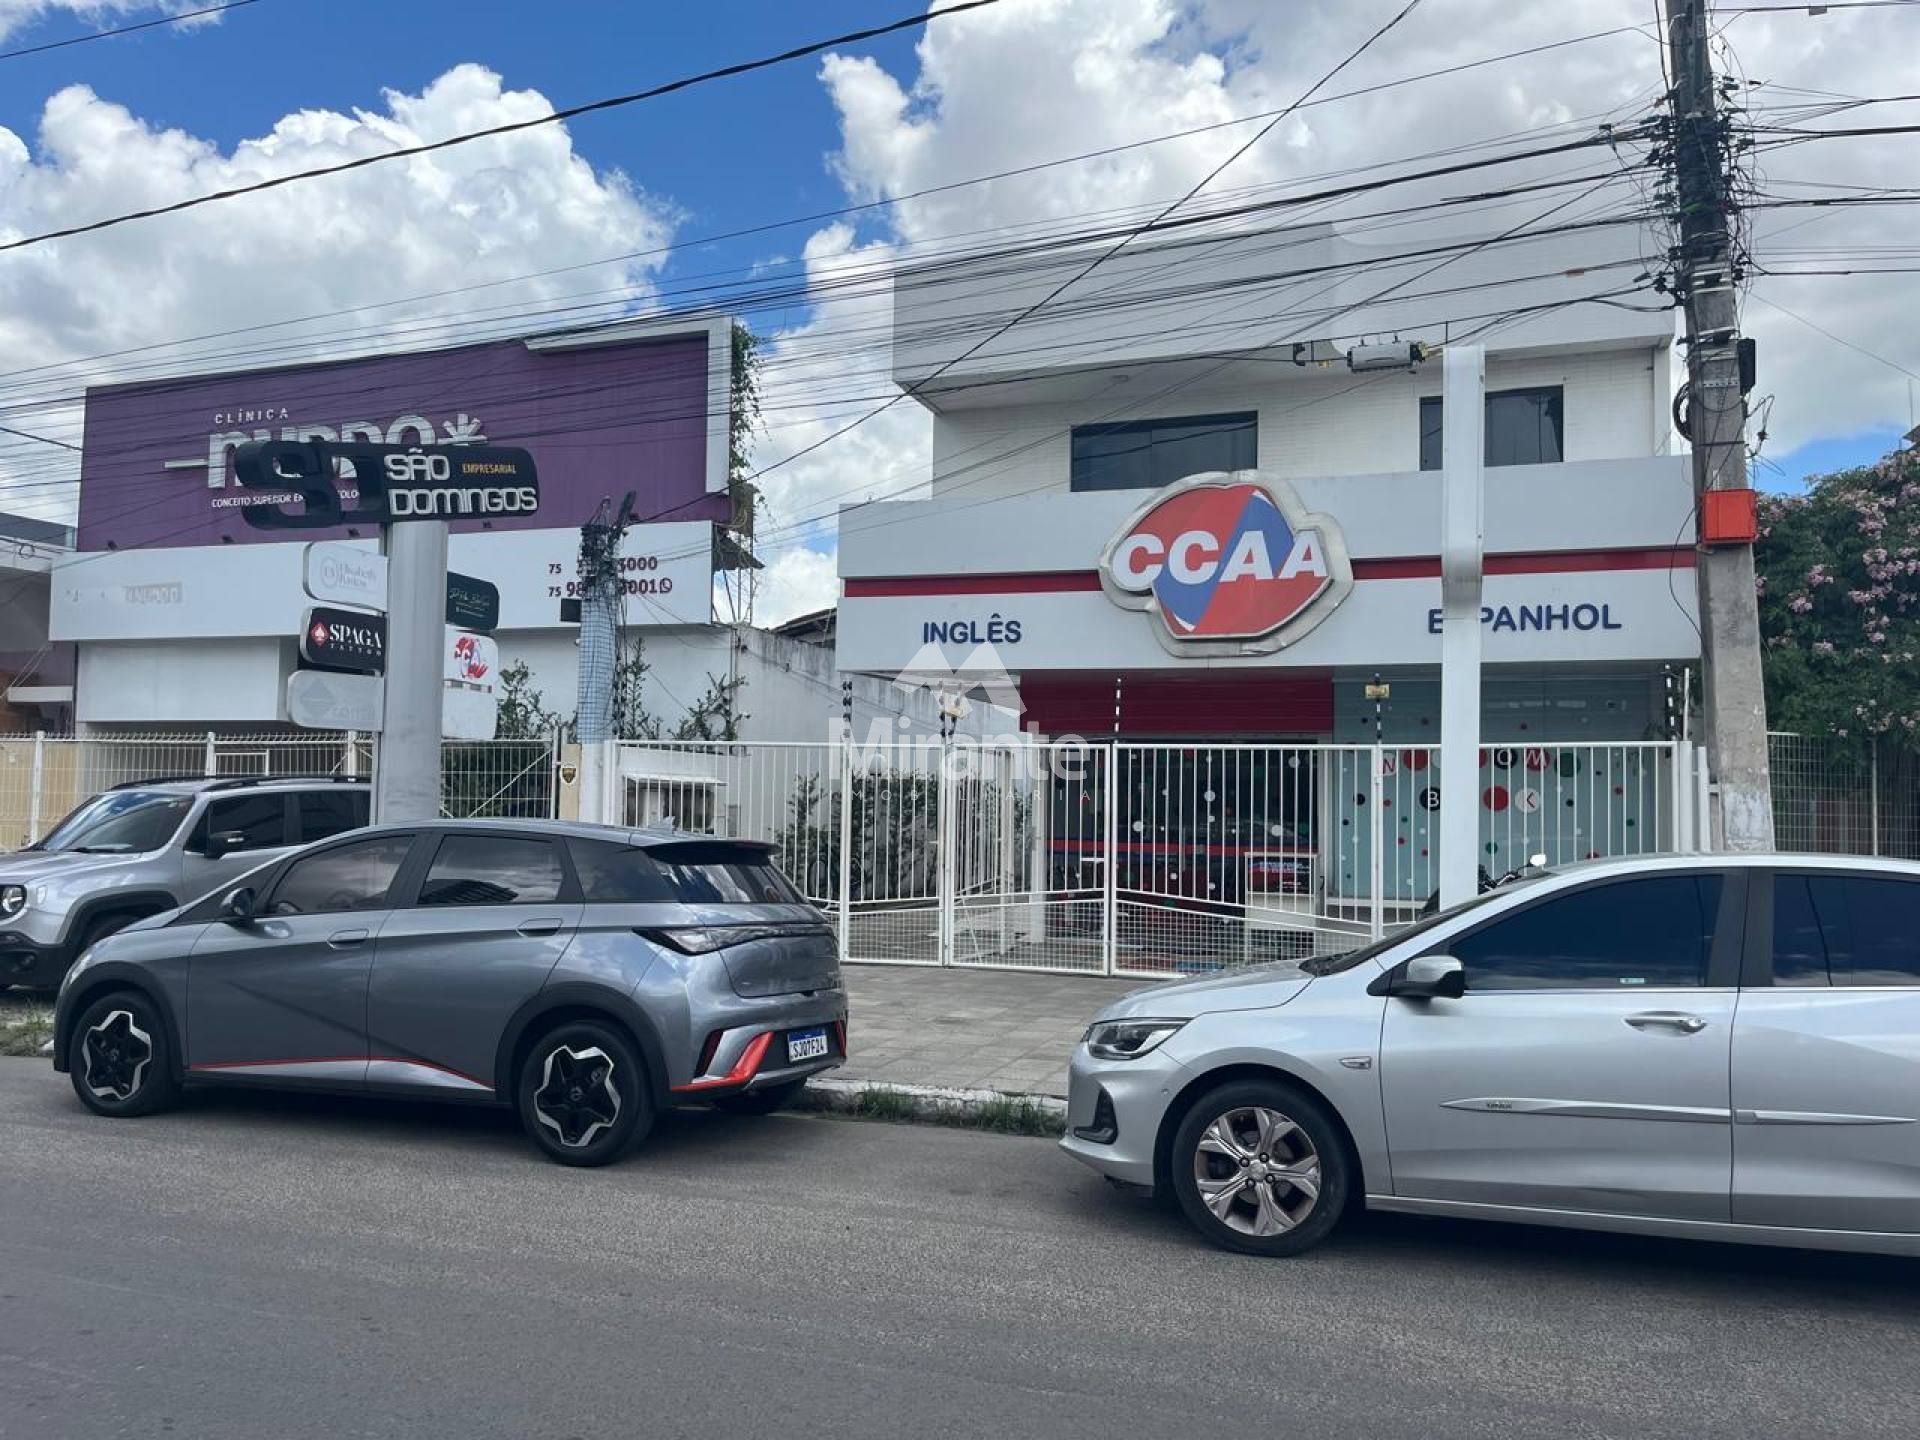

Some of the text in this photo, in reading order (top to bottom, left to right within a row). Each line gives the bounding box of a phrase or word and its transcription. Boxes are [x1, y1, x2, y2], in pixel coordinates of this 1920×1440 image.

[215, 407, 289, 424] CLÍNICA
[384, 447, 450, 481] SÃO
[462, 463, 517, 474] EMPRESARIAL
[253, 494, 291, 505] SUPERIOR
[388, 487, 539, 515] DOMINGOS
[1113, 529, 1329, 589] CCAA
[923, 613, 1022, 643] INGLÊS
[1428, 603, 1623, 634] EPANHOL
[330, 624, 382, 649] SPAGA
